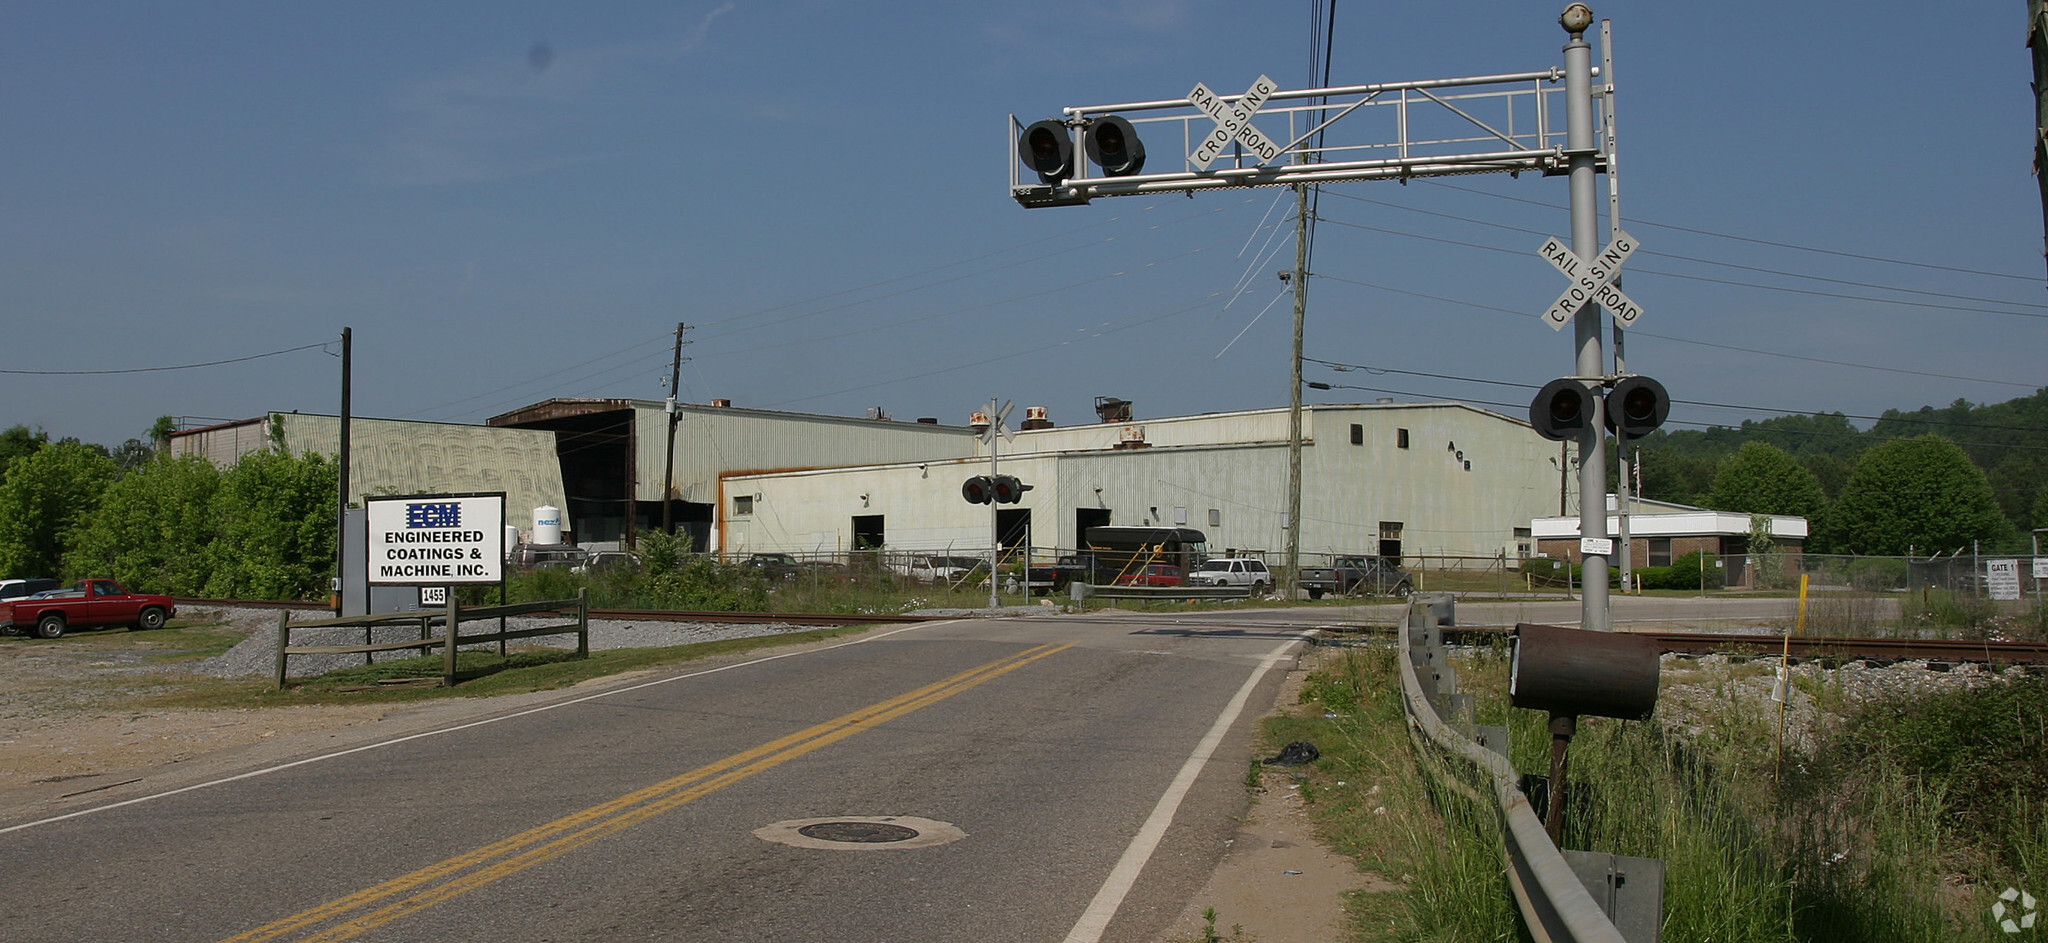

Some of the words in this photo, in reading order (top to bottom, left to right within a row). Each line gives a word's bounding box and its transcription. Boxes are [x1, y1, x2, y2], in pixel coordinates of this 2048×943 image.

[1191, 87, 1223, 120] RAIL
[1197, 83, 1269, 163] CROSSING
[1238, 127, 1275, 161] ROAD
[1542, 241, 1578, 277] RAIL
[1551, 239, 1630, 322] CROSSING
[1596, 285, 1637, 321] ROAD
[408, 503, 460, 528] ECM
[385, 531, 484, 544] ENGINEERED
[386, 548, 464, 560] COATINGS
[469, 547, 482, 559] &
[380, 564, 453, 577] MACHINE,
[457, 564, 489, 576] INC.
[423, 589, 444, 602] 1455
